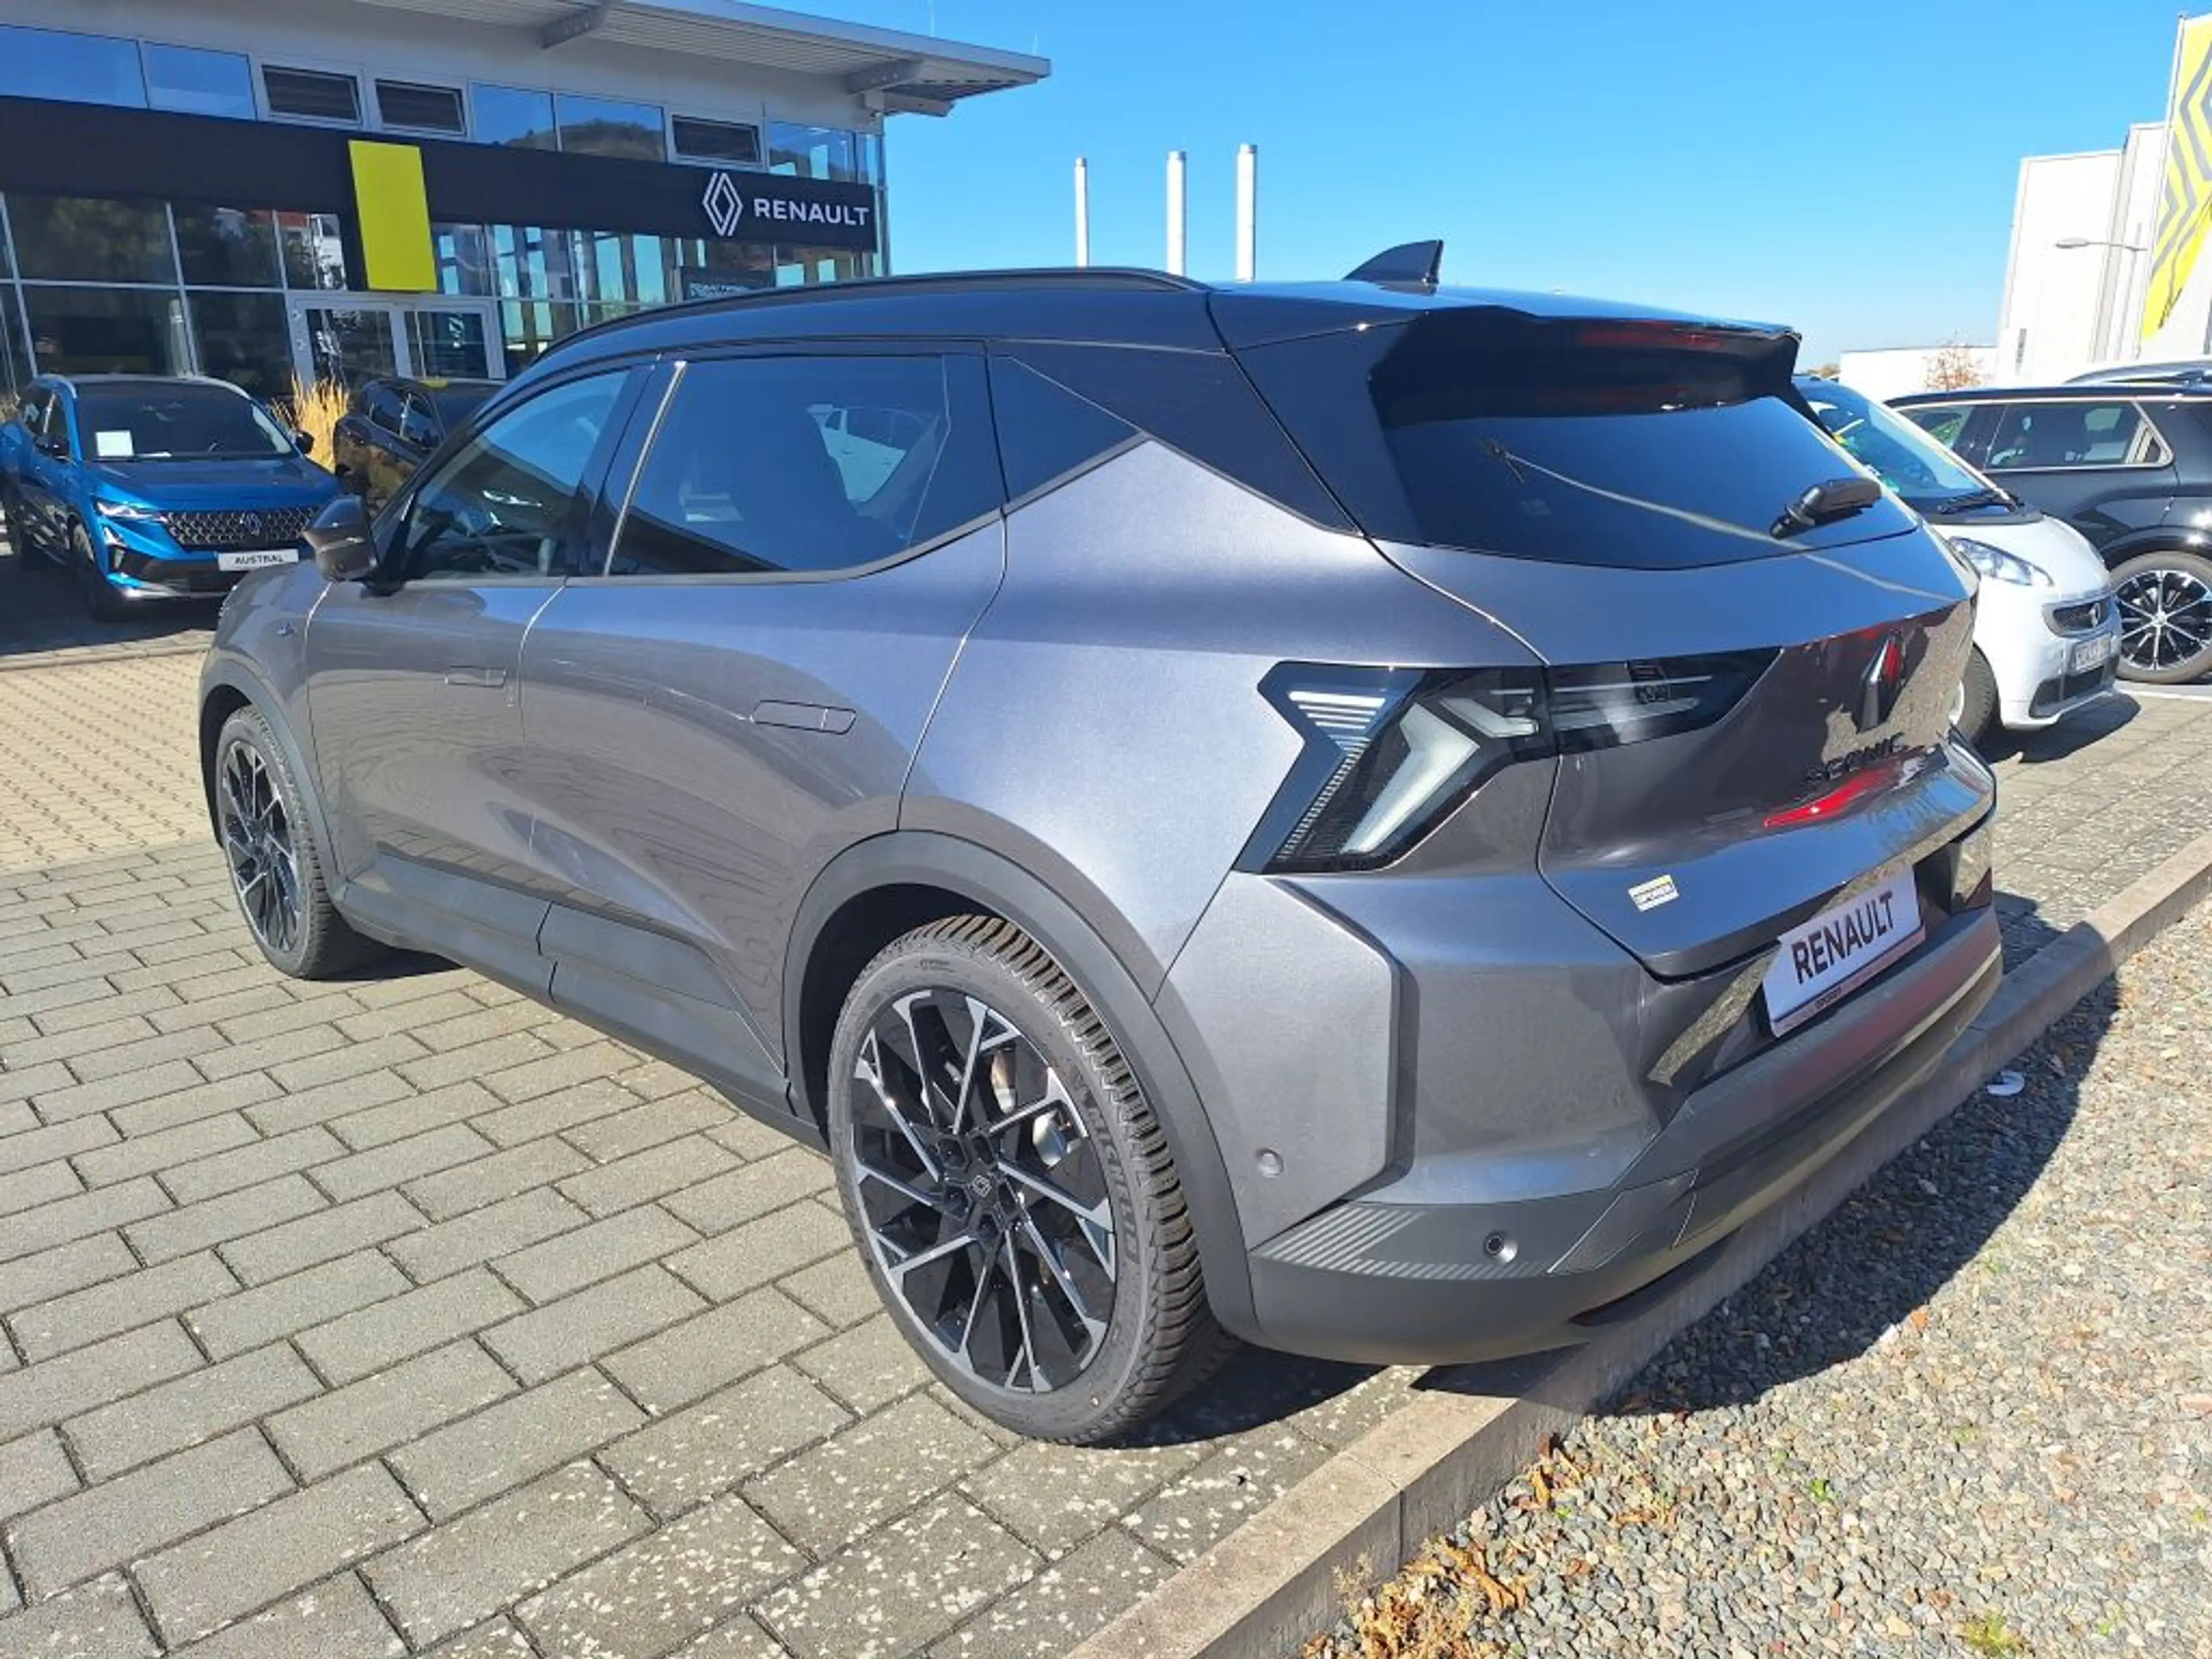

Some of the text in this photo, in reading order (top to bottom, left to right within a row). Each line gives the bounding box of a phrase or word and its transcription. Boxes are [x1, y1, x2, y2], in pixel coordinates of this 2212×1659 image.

[753, 198, 869, 226] RENAULT
[235, 555, 283, 565] AUSTRAL
[1791, 891, 1893, 984] RENAULT
